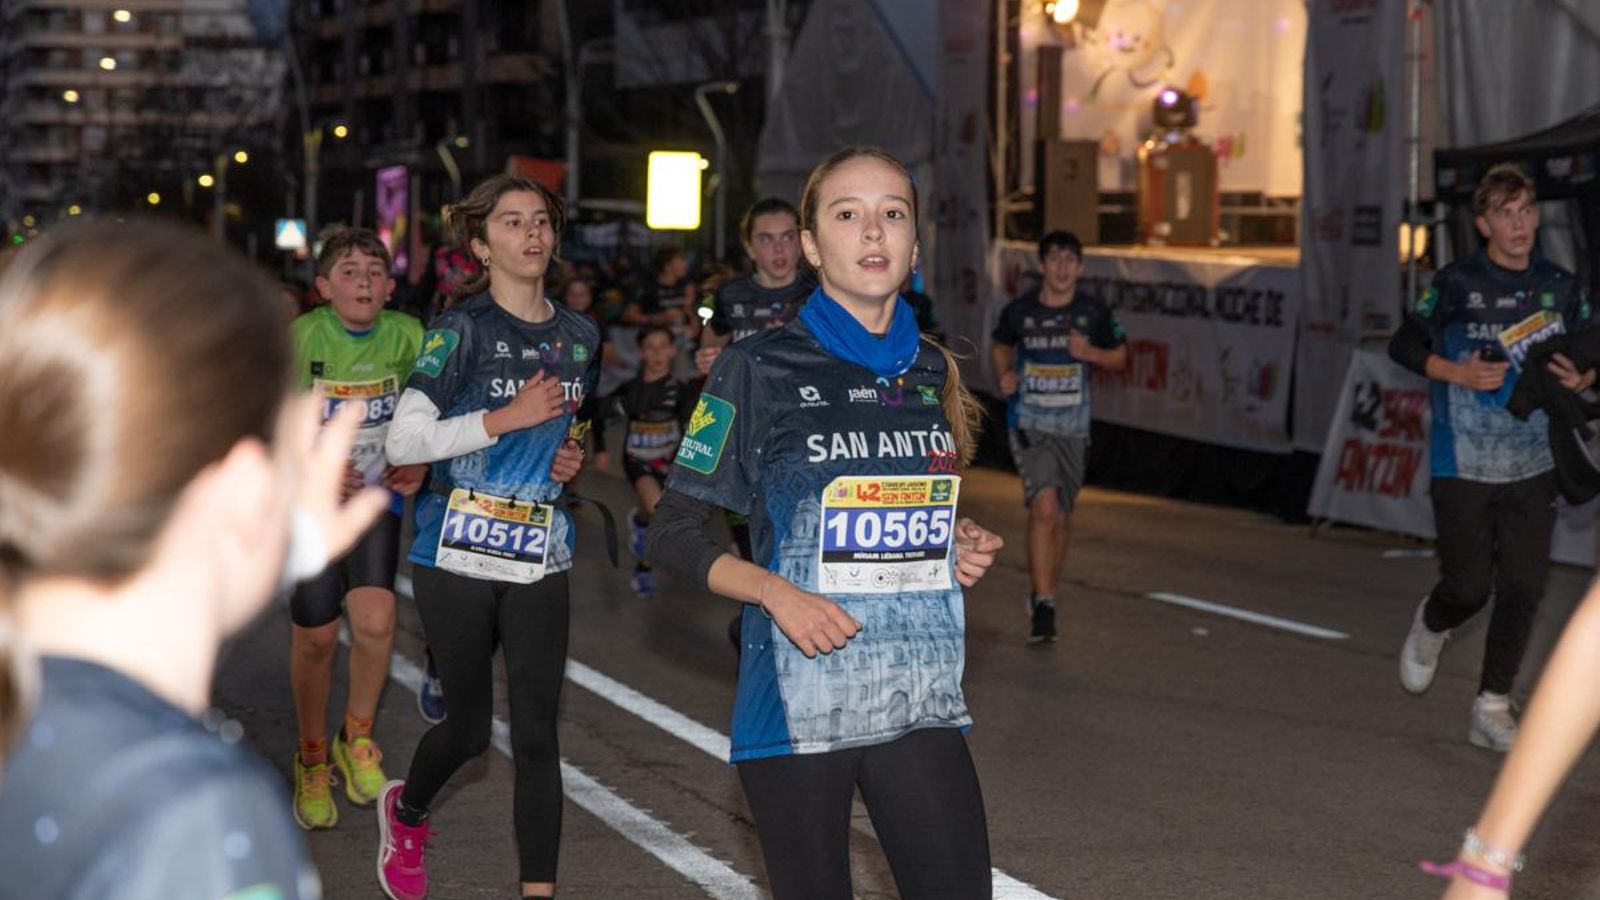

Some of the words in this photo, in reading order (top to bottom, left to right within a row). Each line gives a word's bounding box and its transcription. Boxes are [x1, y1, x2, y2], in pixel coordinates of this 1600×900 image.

[681, 436, 713, 457] RURAL
[807, 431, 870, 463] SAN
[856, 482, 882, 502] 42
[448, 513, 547, 554] 10512
[827, 509, 950, 548] 10565
